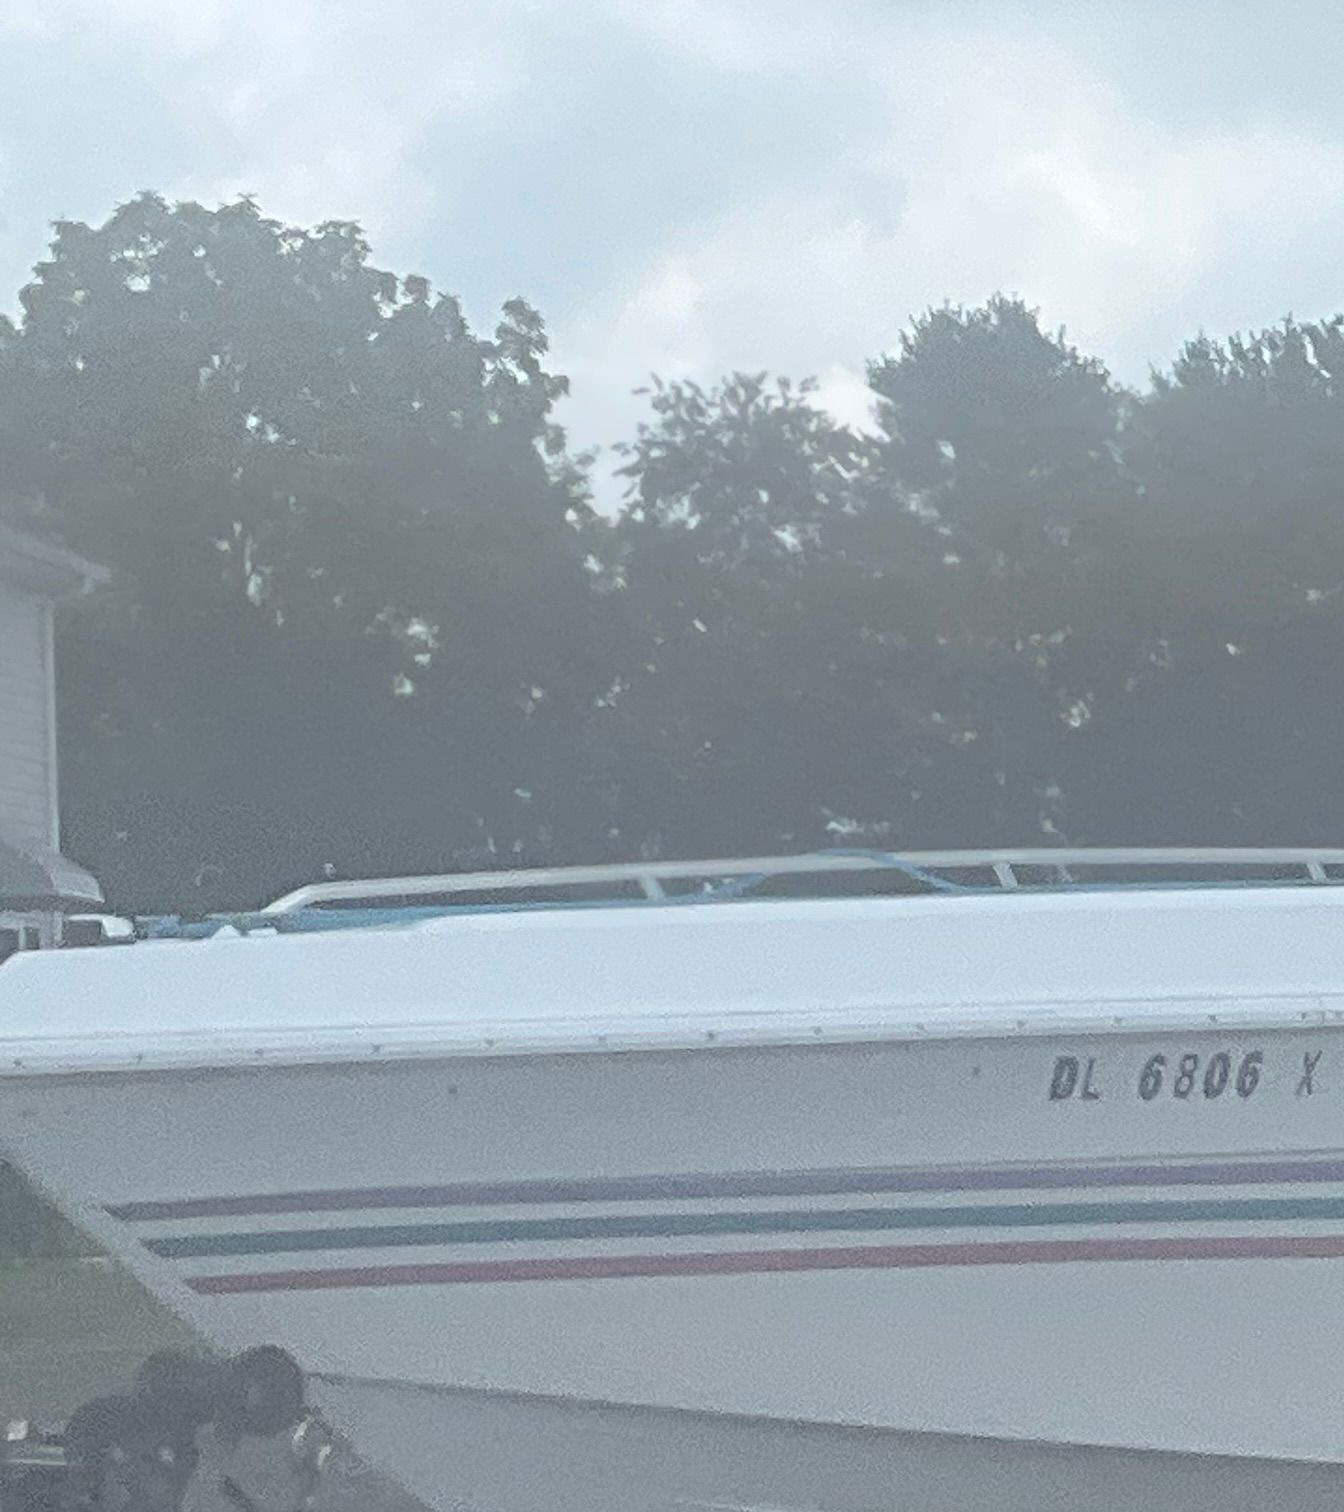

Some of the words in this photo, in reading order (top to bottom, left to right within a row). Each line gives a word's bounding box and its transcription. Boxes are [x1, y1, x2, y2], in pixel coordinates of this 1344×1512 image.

[1050, 1055, 1101, 1101] DL
[1138, 1050, 1264, 1101] 6806
[1300, 1050, 1323, 1097] X
